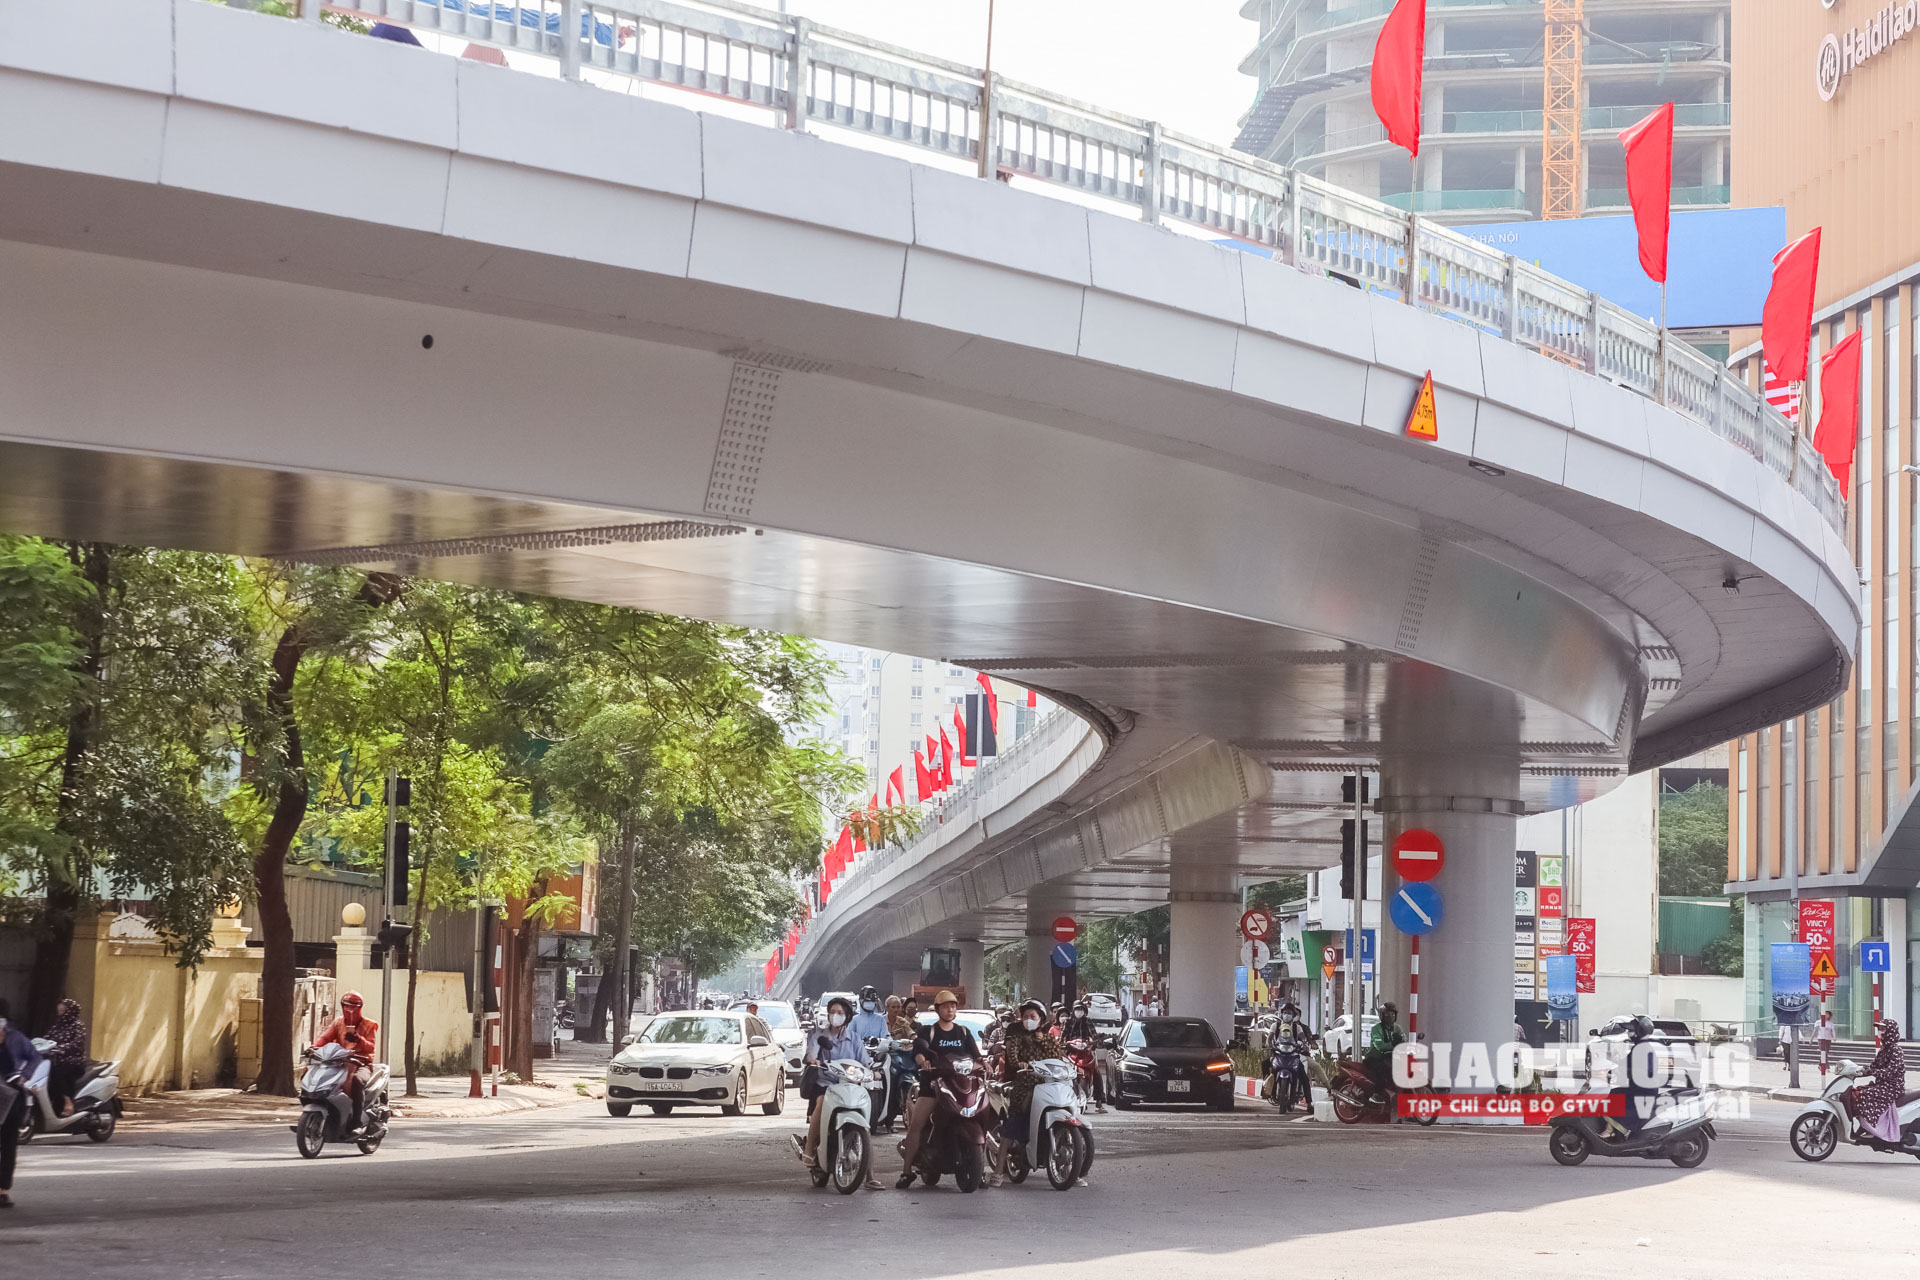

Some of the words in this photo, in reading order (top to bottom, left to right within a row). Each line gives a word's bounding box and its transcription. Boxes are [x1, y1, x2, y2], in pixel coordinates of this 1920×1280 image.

[1479, 232, 1496, 244] HÀ
[1498, 231, 1519, 245] NỘI
[1547, 867, 1560, 875] BHD
[1572, 941, 1591, 952] 50%
